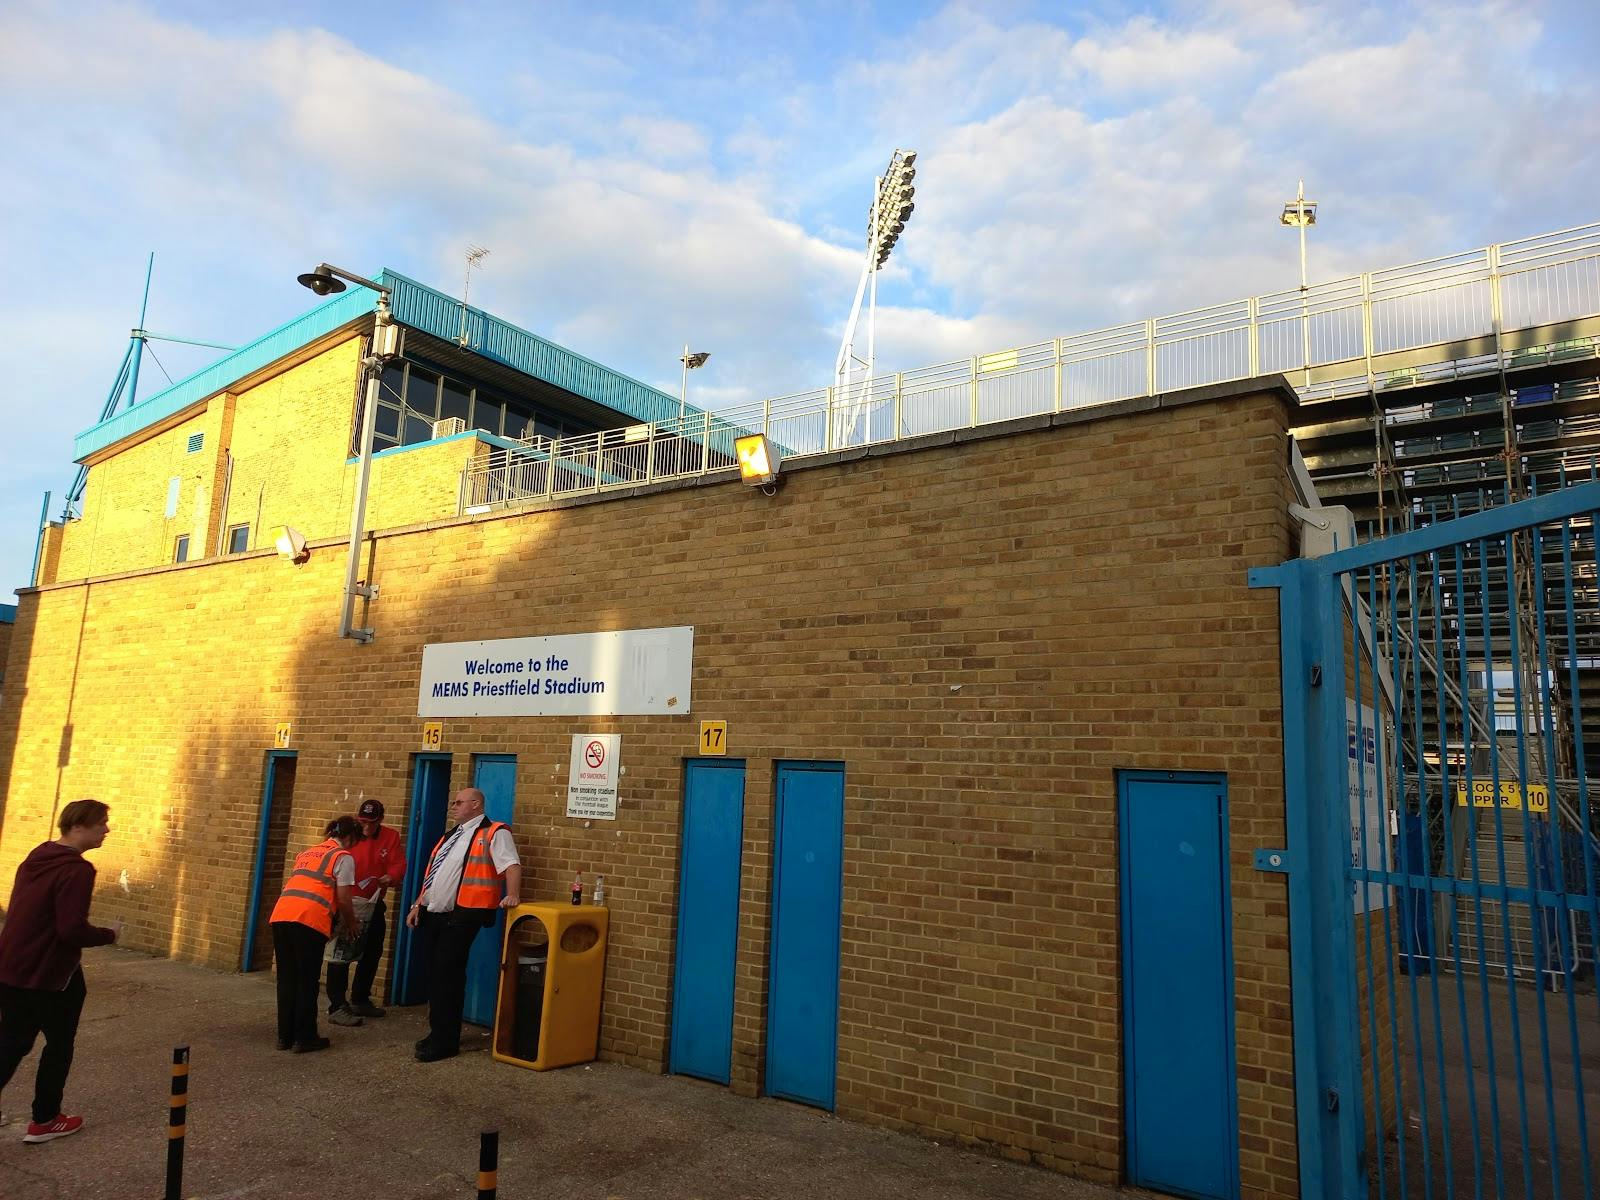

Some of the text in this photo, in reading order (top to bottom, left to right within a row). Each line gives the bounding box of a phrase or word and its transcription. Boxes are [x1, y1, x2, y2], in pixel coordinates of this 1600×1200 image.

[465, 655, 568, 675] Welcome to the
[432, 677, 605, 698] MEMS Priestfield Stadium
[426, 729, 439, 744] 15
[703, 728, 723, 747] 17
[580, 787, 597, 795] smoking
[1459, 784, 1515, 793] BOCK 5
[1466, 795, 1510, 805] PPR
